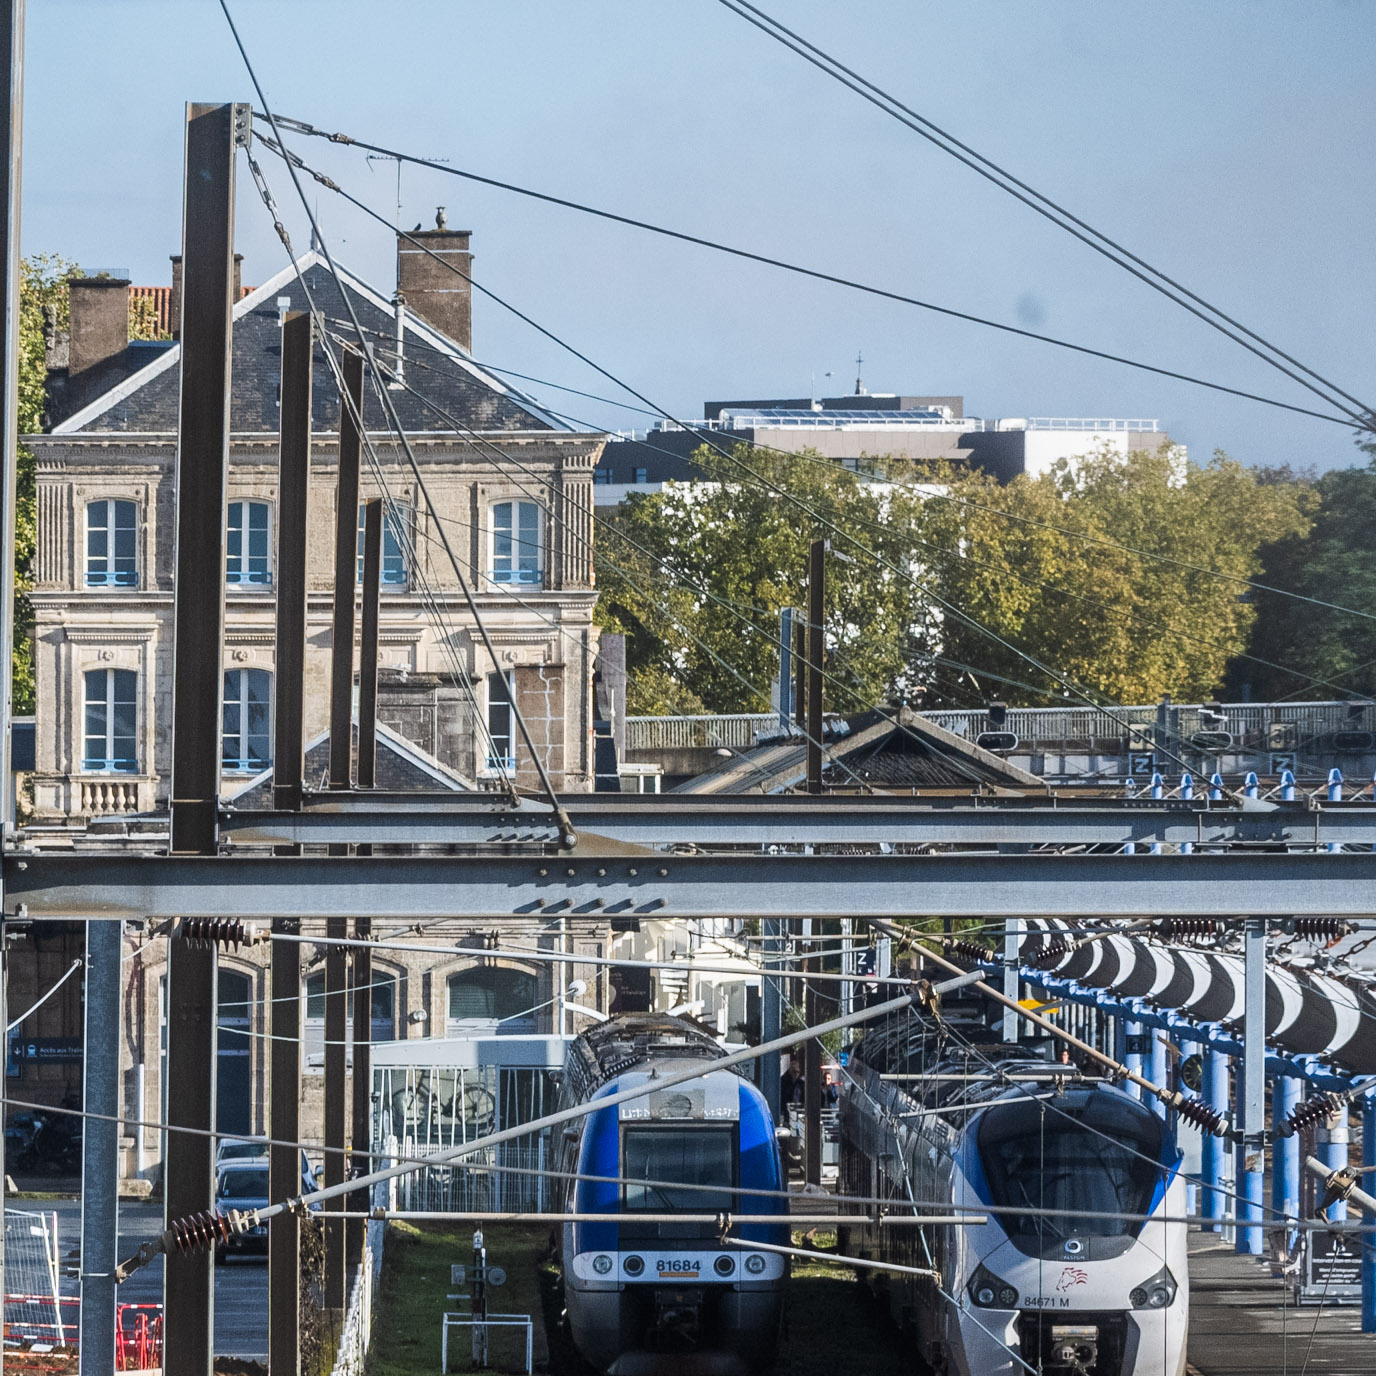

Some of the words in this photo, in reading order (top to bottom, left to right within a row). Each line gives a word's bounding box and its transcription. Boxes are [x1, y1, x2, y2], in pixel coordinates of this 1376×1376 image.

[785, 942, 792, 952] 2
[857, 952, 867, 965] Z
[656, 1259, 702, 1272] 81684
[1024, 1297, 1055, 1307] 84671
[1060, 1298, 1070, 1307] M
